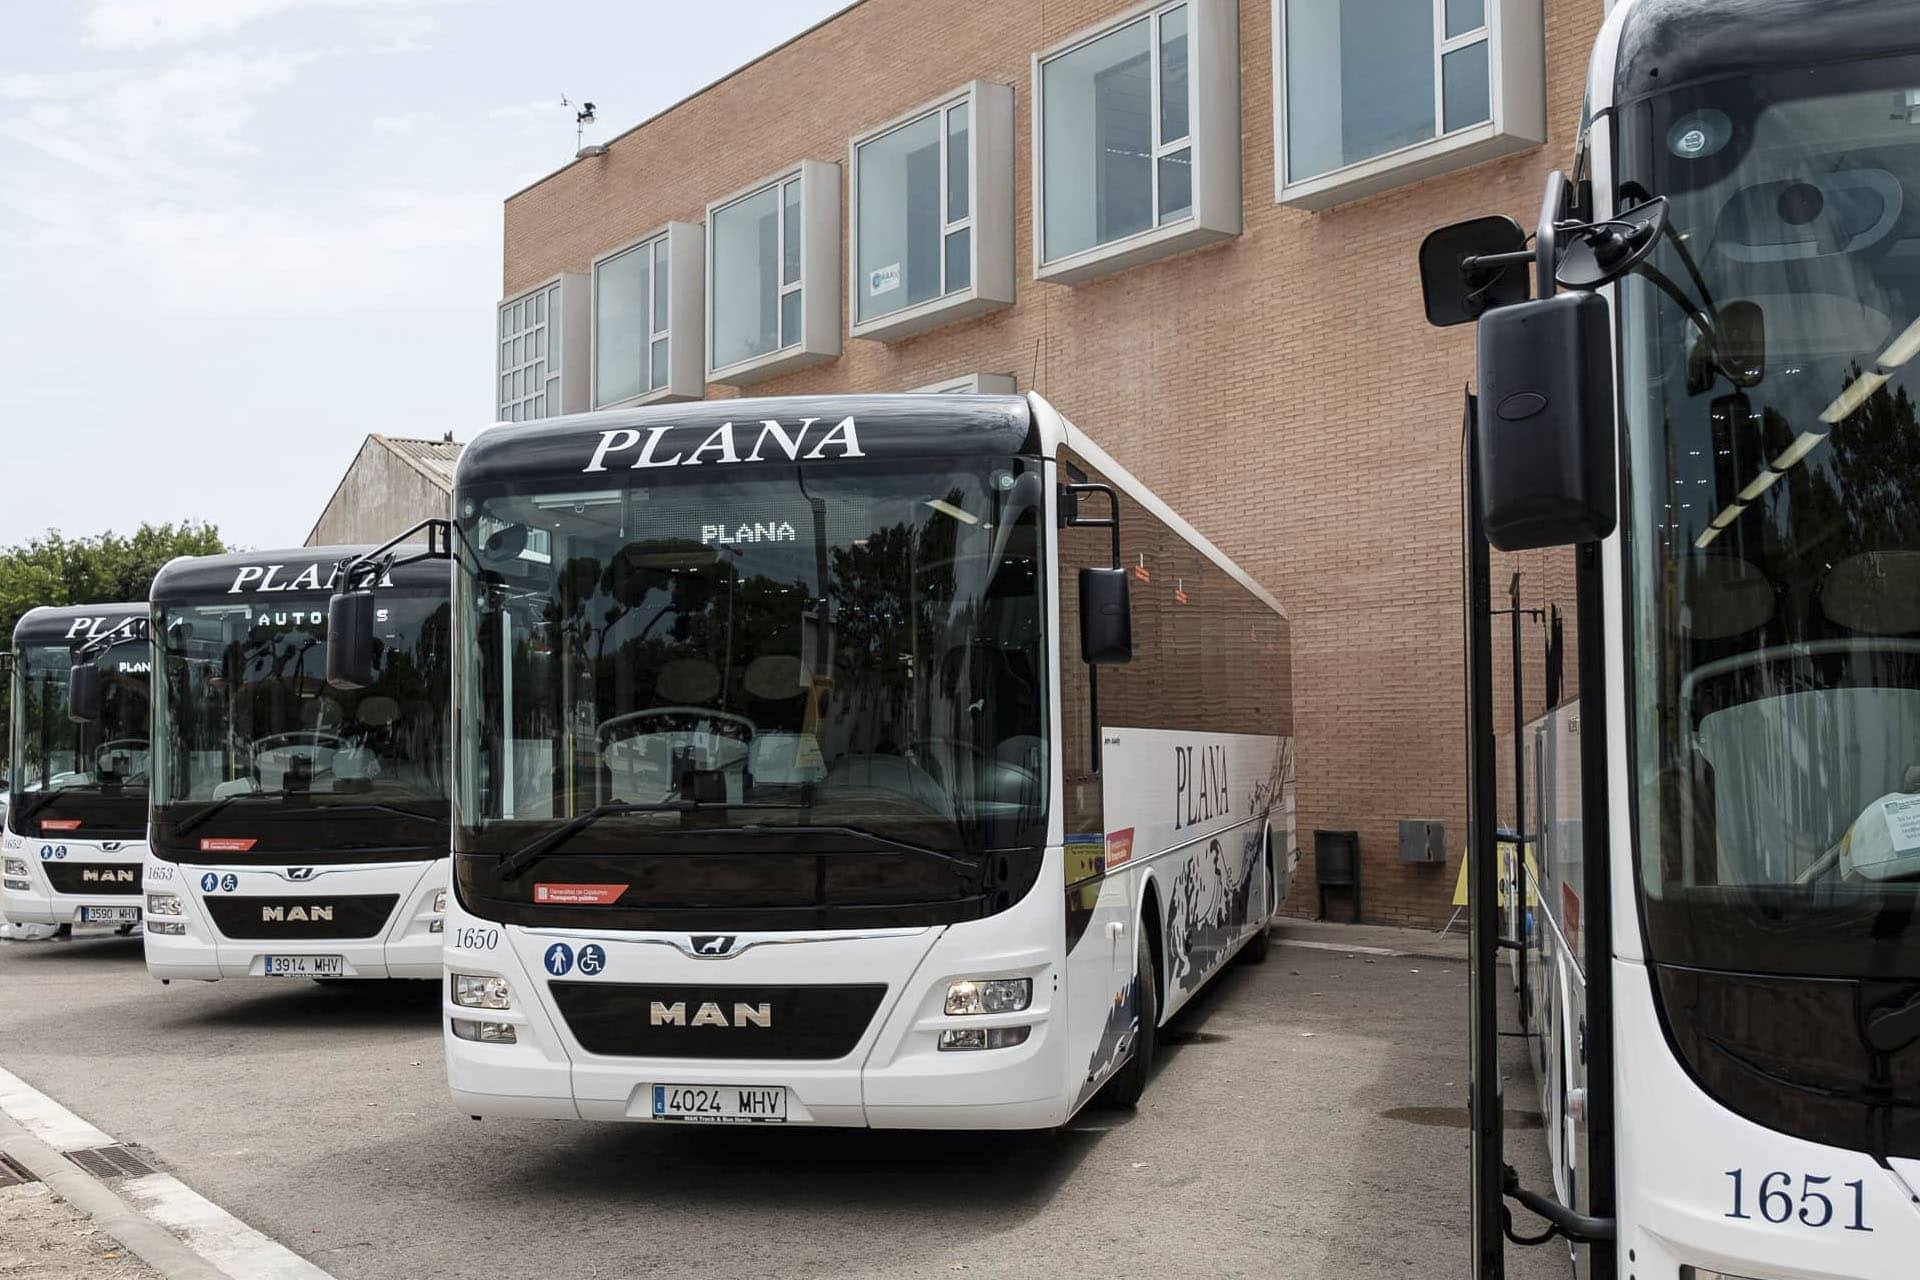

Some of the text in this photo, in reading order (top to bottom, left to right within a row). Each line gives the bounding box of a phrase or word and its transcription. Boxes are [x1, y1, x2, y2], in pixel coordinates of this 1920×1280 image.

[582, 416, 866, 473] PLANA
[702, 521, 796, 545] PLANA
[258, 609, 389, 626] AUTOS
[119, 661, 151, 673] PLAN
[1175, 744, 1229, 831] PLANA
[82, 869, 135, 882] MAN
[148, 866, 175, 882] 1653
[90, 908, 137, 920] 3590 MHV
[261, 905, 334, 922] MAN
[455, 927, 499, 951] 1650
[275, 957, 338, 973] 3914 MHV
[650, 1001, 772, 1028] MAN
[669, 1089, 779, 1114] 4024 MHV
[1725, 1167, 1874, 1232] 1651
